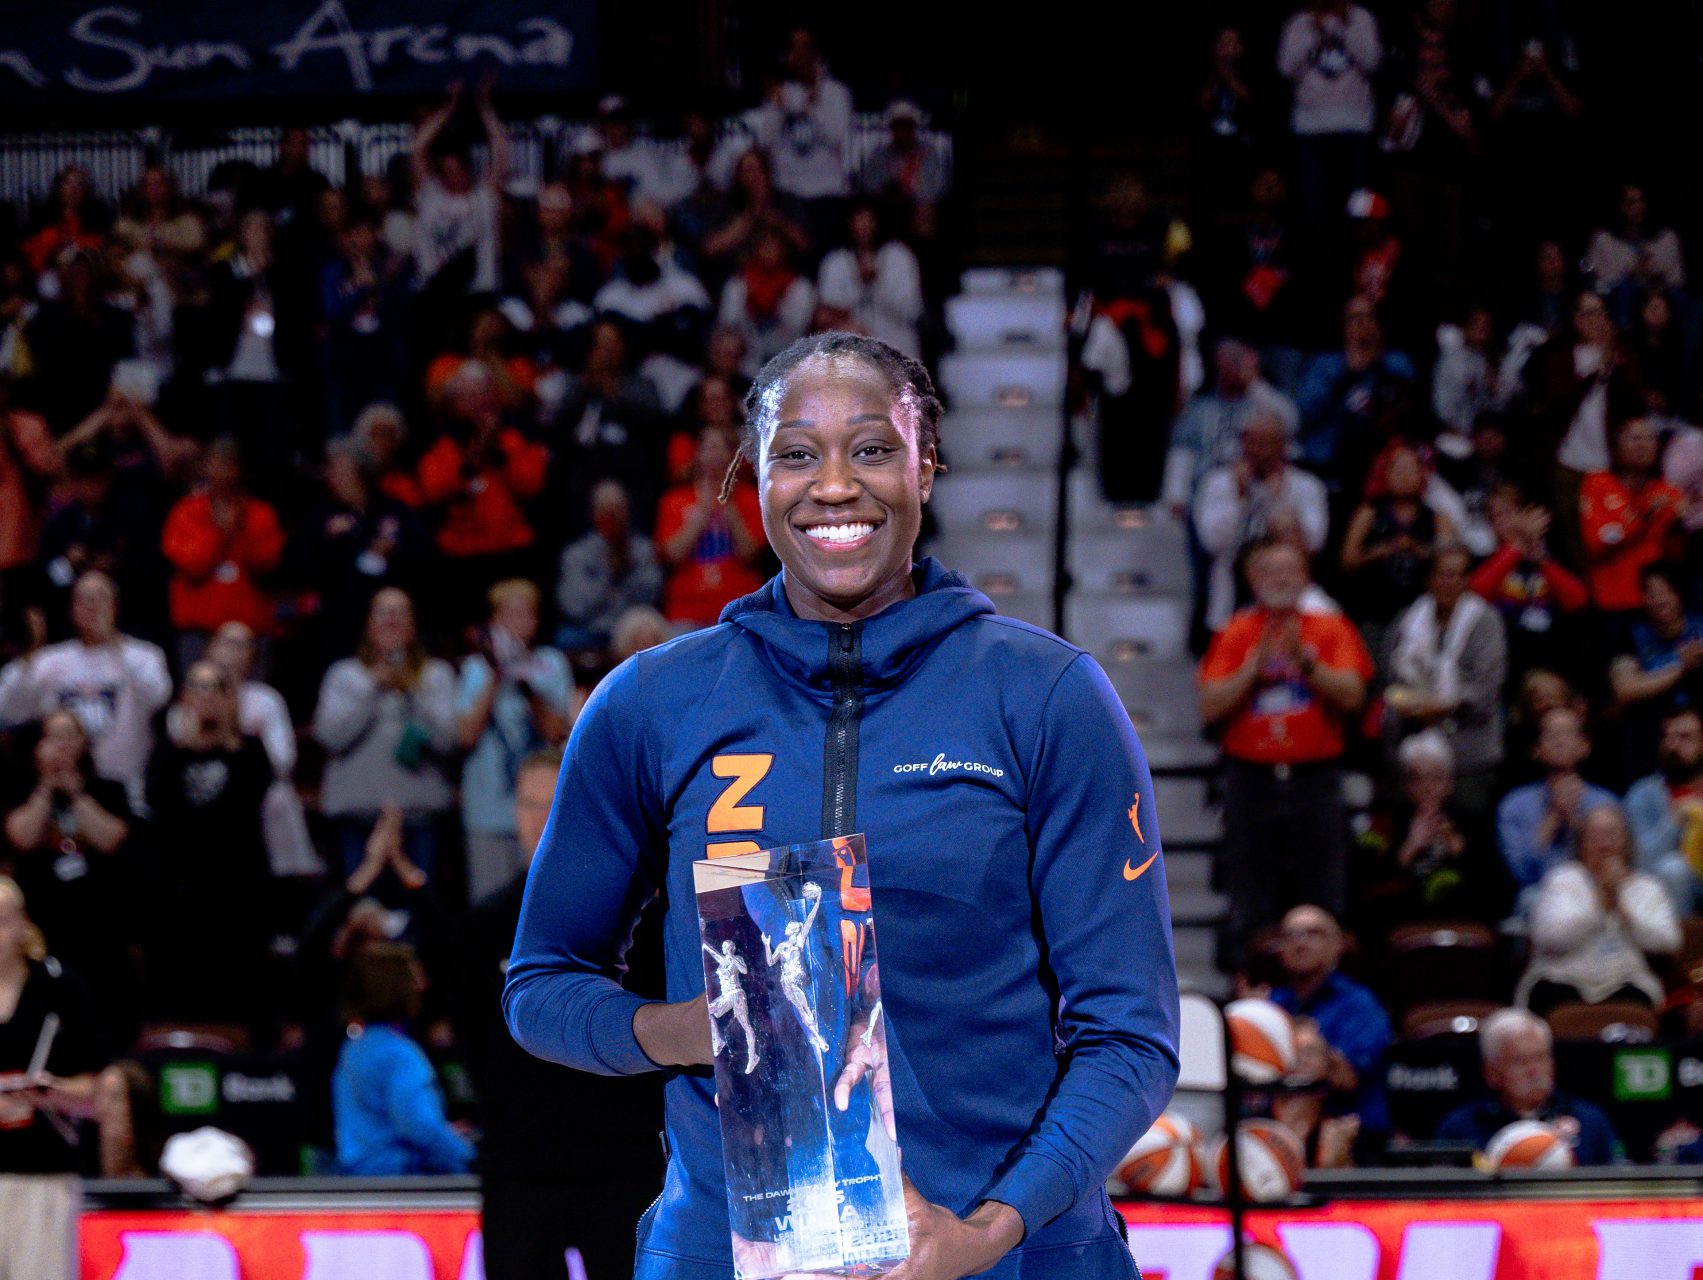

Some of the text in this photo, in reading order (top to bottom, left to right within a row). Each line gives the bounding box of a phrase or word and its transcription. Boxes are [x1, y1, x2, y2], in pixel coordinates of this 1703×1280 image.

[64, 5, 252, 93] Sun
[270, 0, 574, 92] Arena
[893, 752, 1004, 778] GOFF law GROUP
[742, 1193, 764, 1202] THE
[765, 1188, 797, 1199] DAW
[842, 1173, 885, 1187] TROPHY
